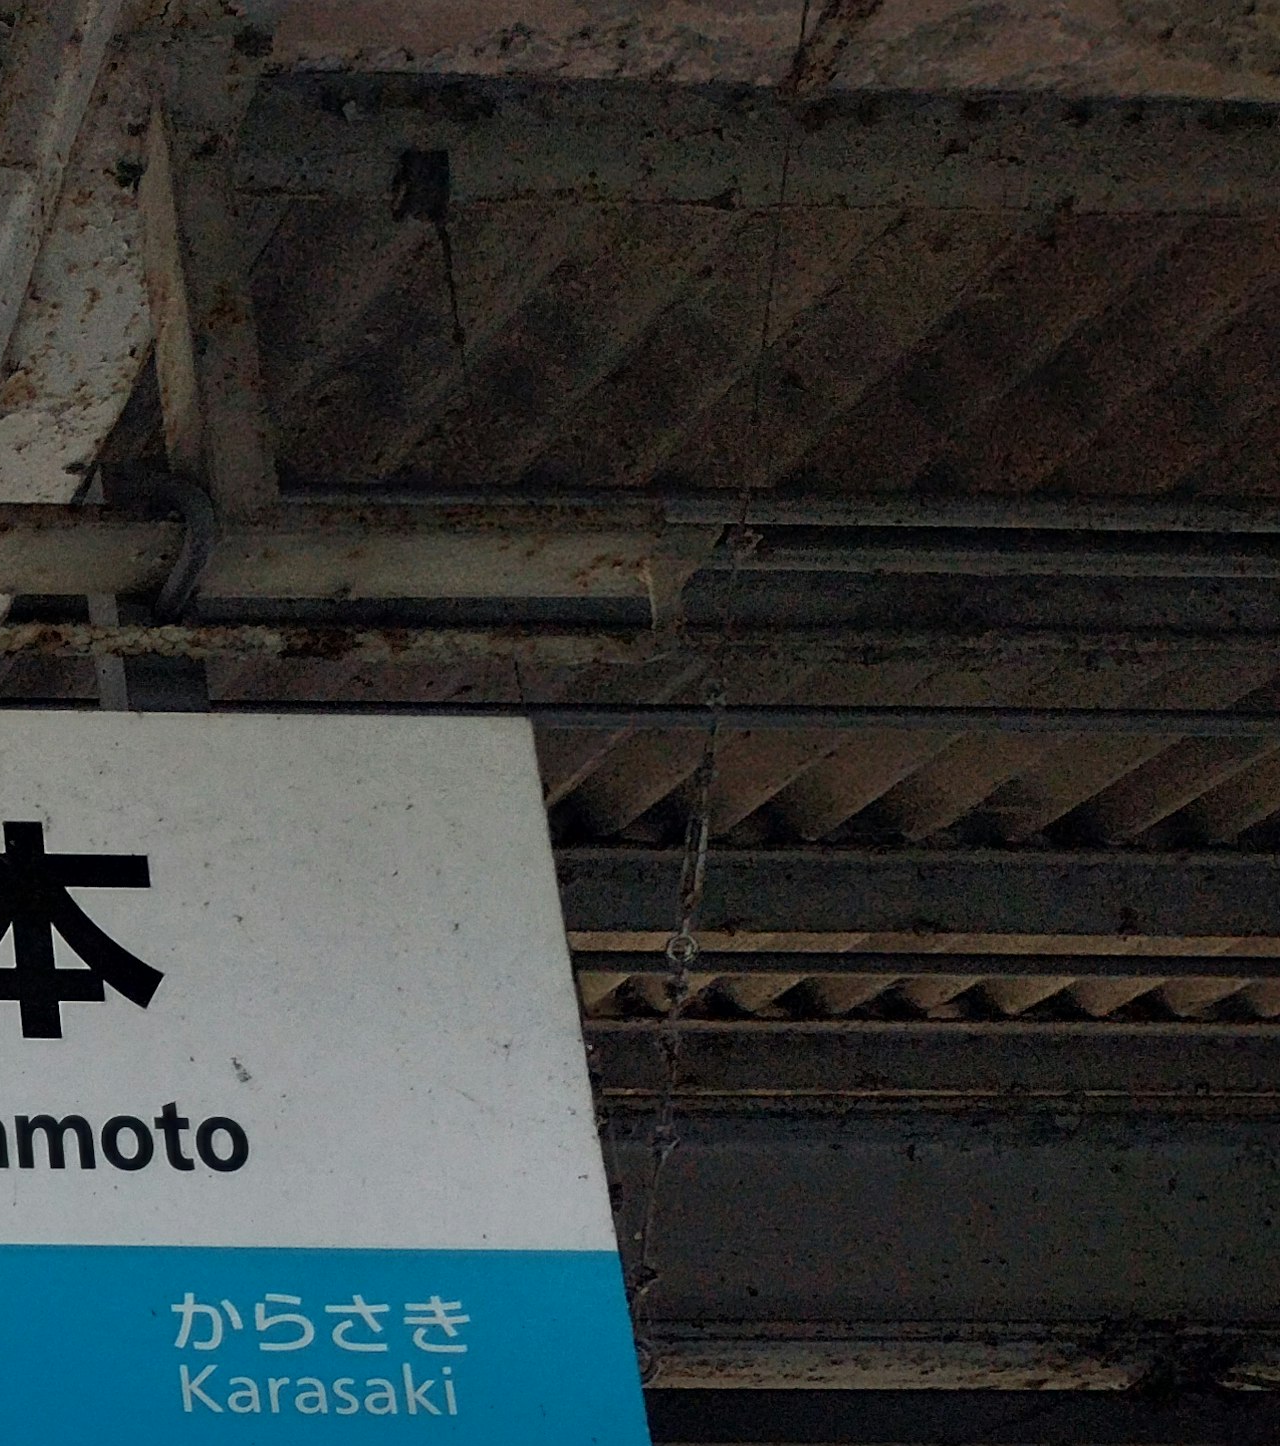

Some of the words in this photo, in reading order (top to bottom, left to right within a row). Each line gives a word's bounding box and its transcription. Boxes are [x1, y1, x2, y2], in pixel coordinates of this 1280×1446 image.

[172, 1292, 470, 1354] からさき
[180, 1364, 459, 1417] Karasaki
